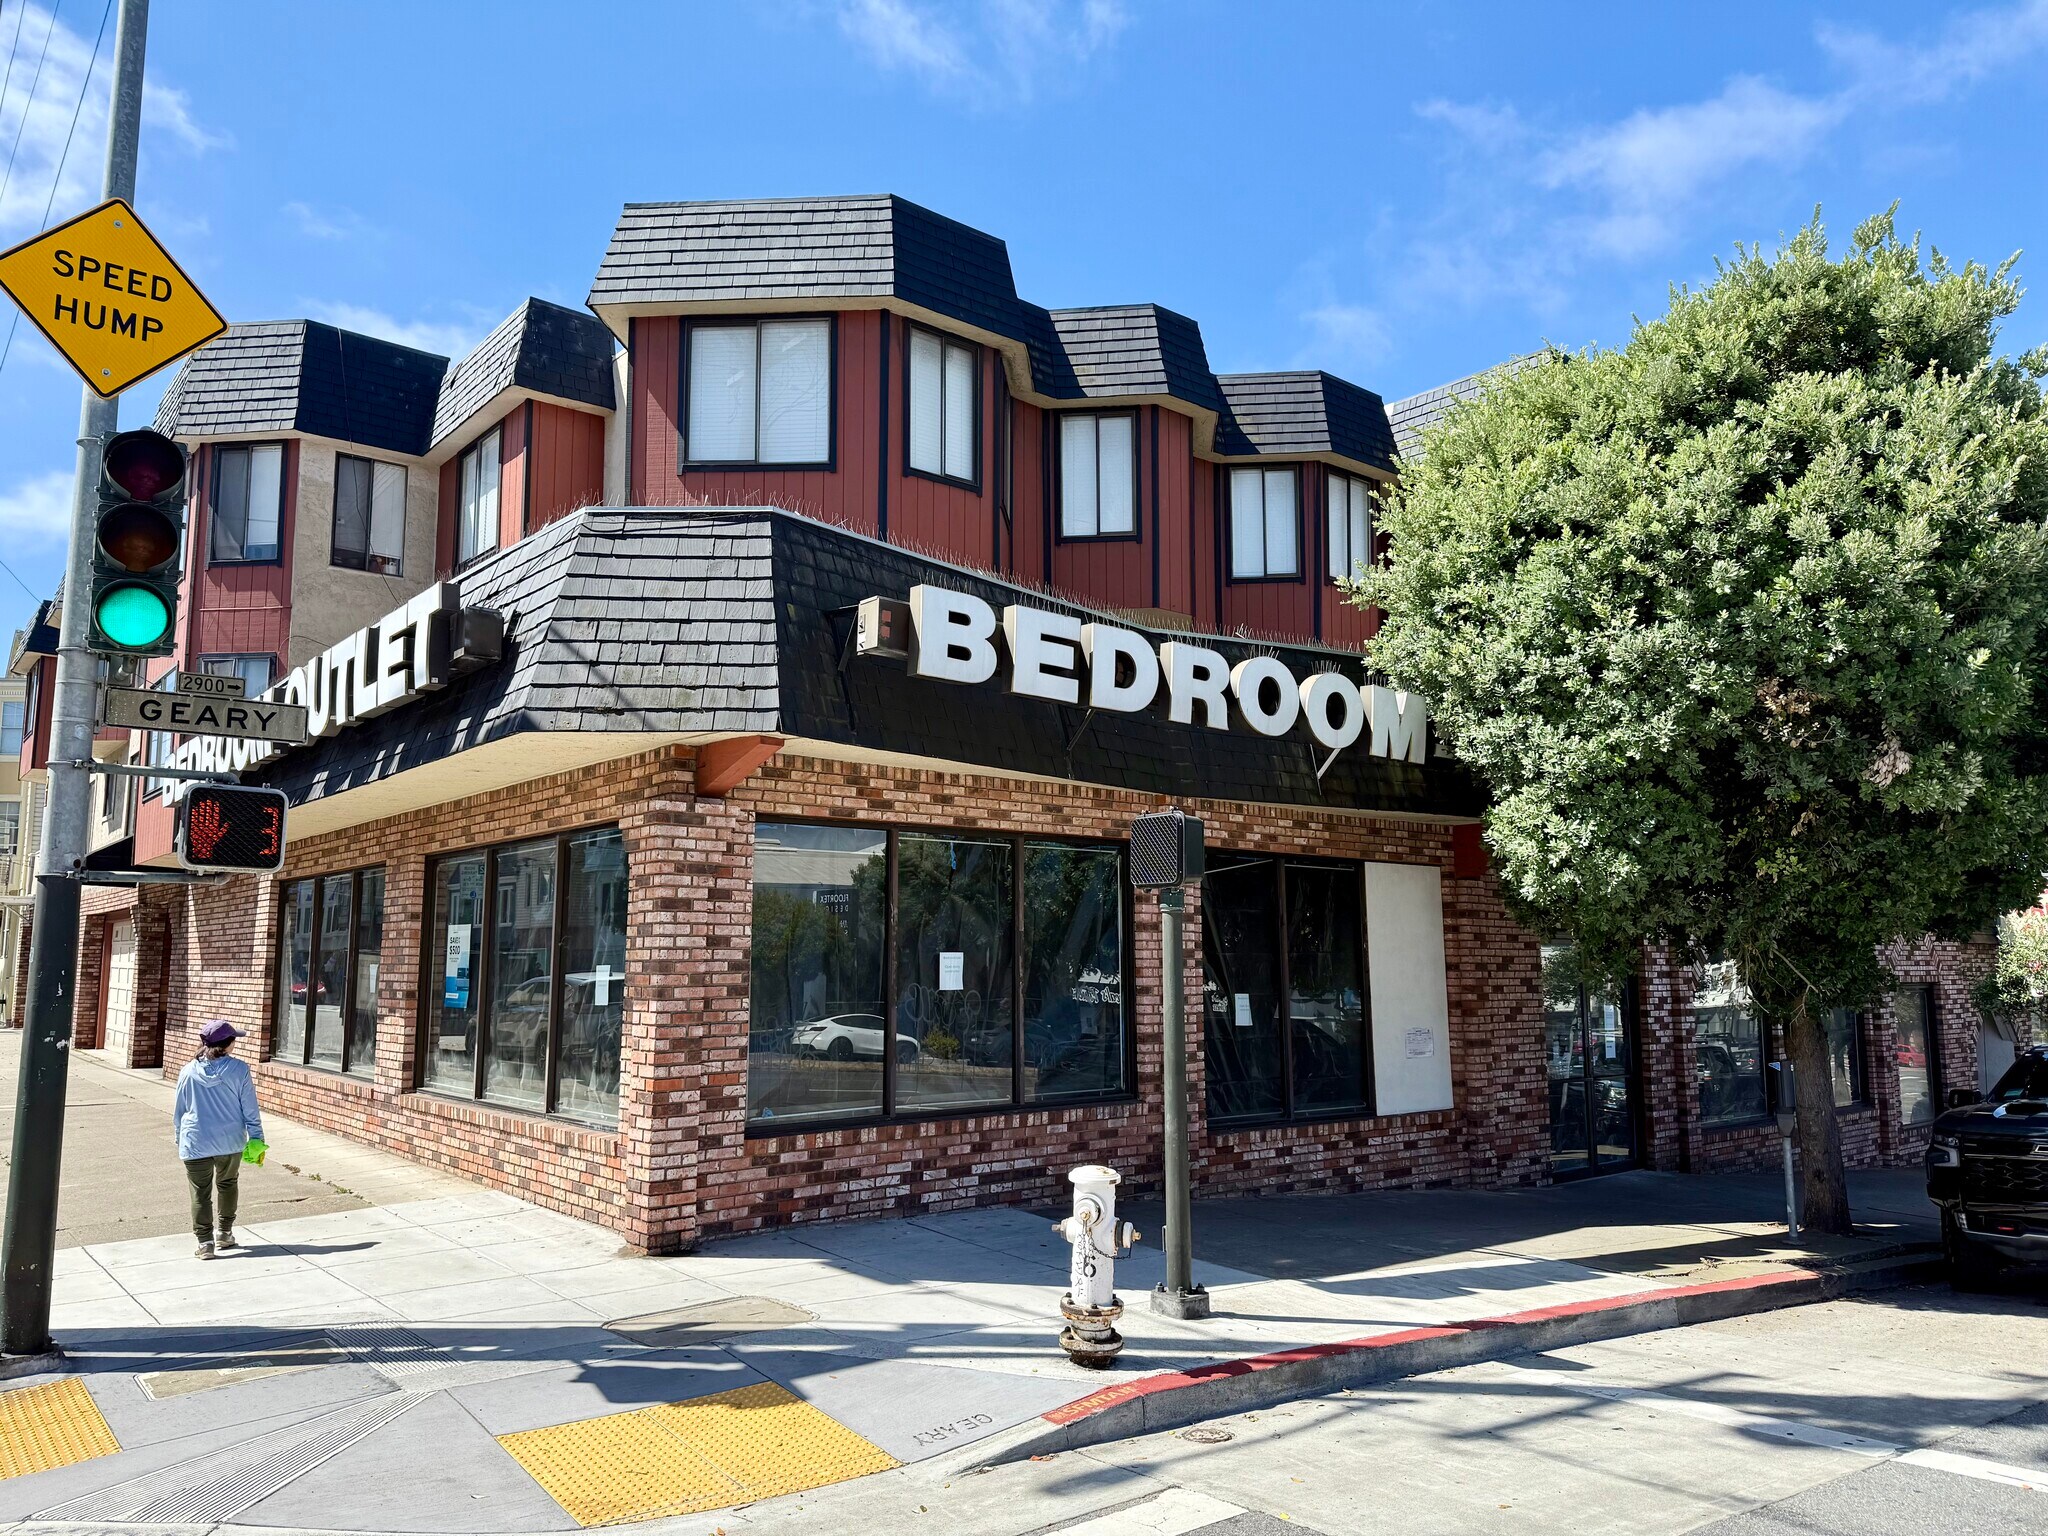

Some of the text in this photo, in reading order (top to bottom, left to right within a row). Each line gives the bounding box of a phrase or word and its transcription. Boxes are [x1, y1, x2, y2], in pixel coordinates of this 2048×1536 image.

[52, 249, 173, 303] SPEED
[53, 293, 164, 342] HUMP
[183, 676, 225, 693] 2900
[910, 584, 1427, 766] BEDROOM
[139, 699, 278, 732] GEARY
[259, 806, 279, 855] 3
[912, 1413, 993, 1447] GEARY
